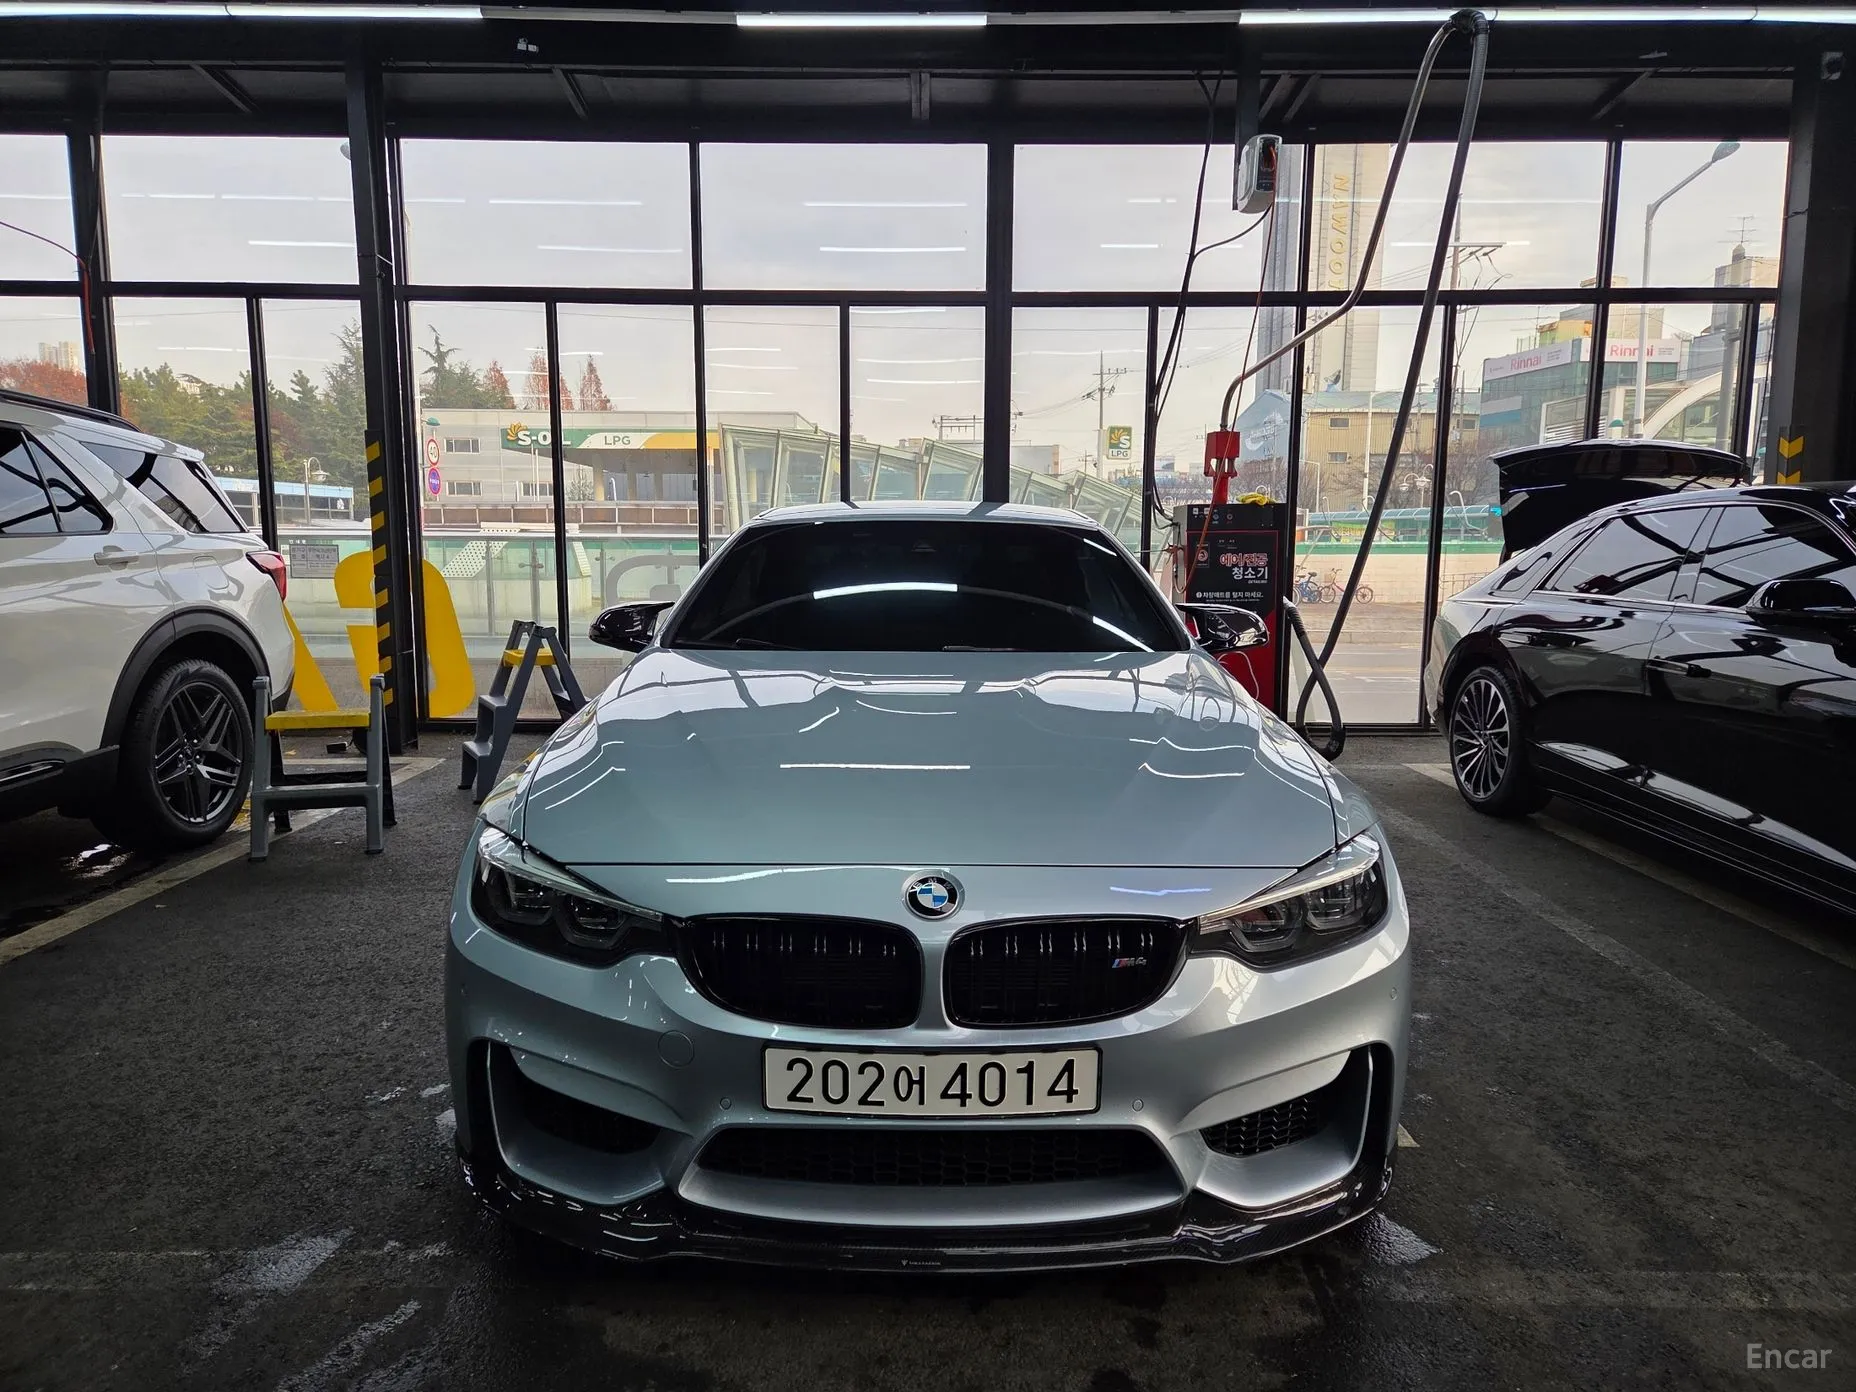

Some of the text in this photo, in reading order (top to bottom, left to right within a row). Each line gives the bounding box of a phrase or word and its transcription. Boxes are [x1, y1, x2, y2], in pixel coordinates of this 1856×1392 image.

[517, 431, 572, 445] S-OL
[604, 435, 631, 446] LPG
[1111, 450, 1128, 458] LPG
[1232, 566, 1268, 580] 청소기
[940, 1059, 1079, 1107] 4014
